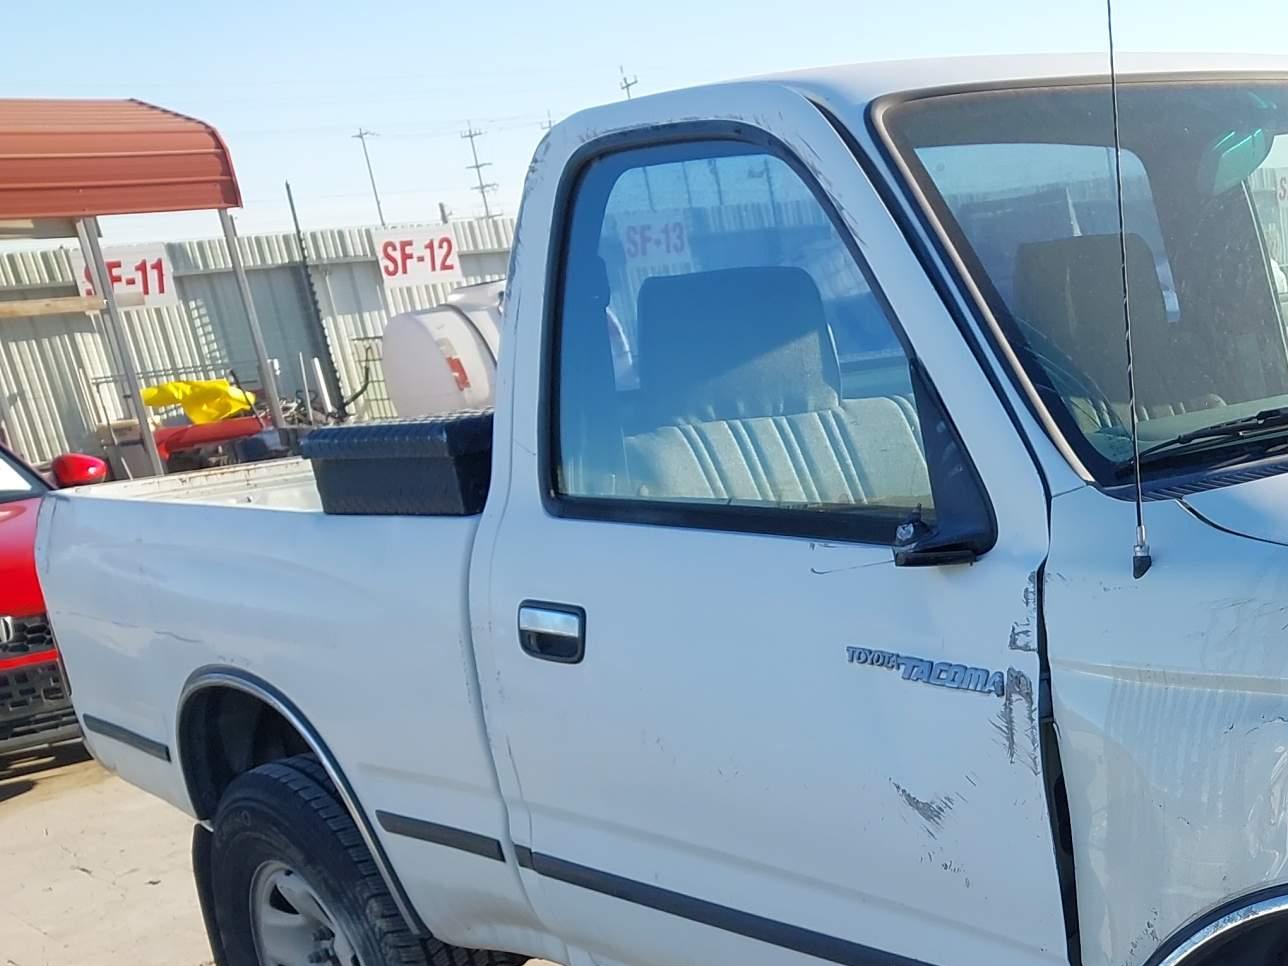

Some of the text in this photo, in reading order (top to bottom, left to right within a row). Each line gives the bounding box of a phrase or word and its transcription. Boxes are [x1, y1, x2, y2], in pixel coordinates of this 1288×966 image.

[382, 236, 455, 276] SF-12
[626, 222, 685, 258] SF-13
[846, 645, 1005, 697] TOYOTA TACOMA
